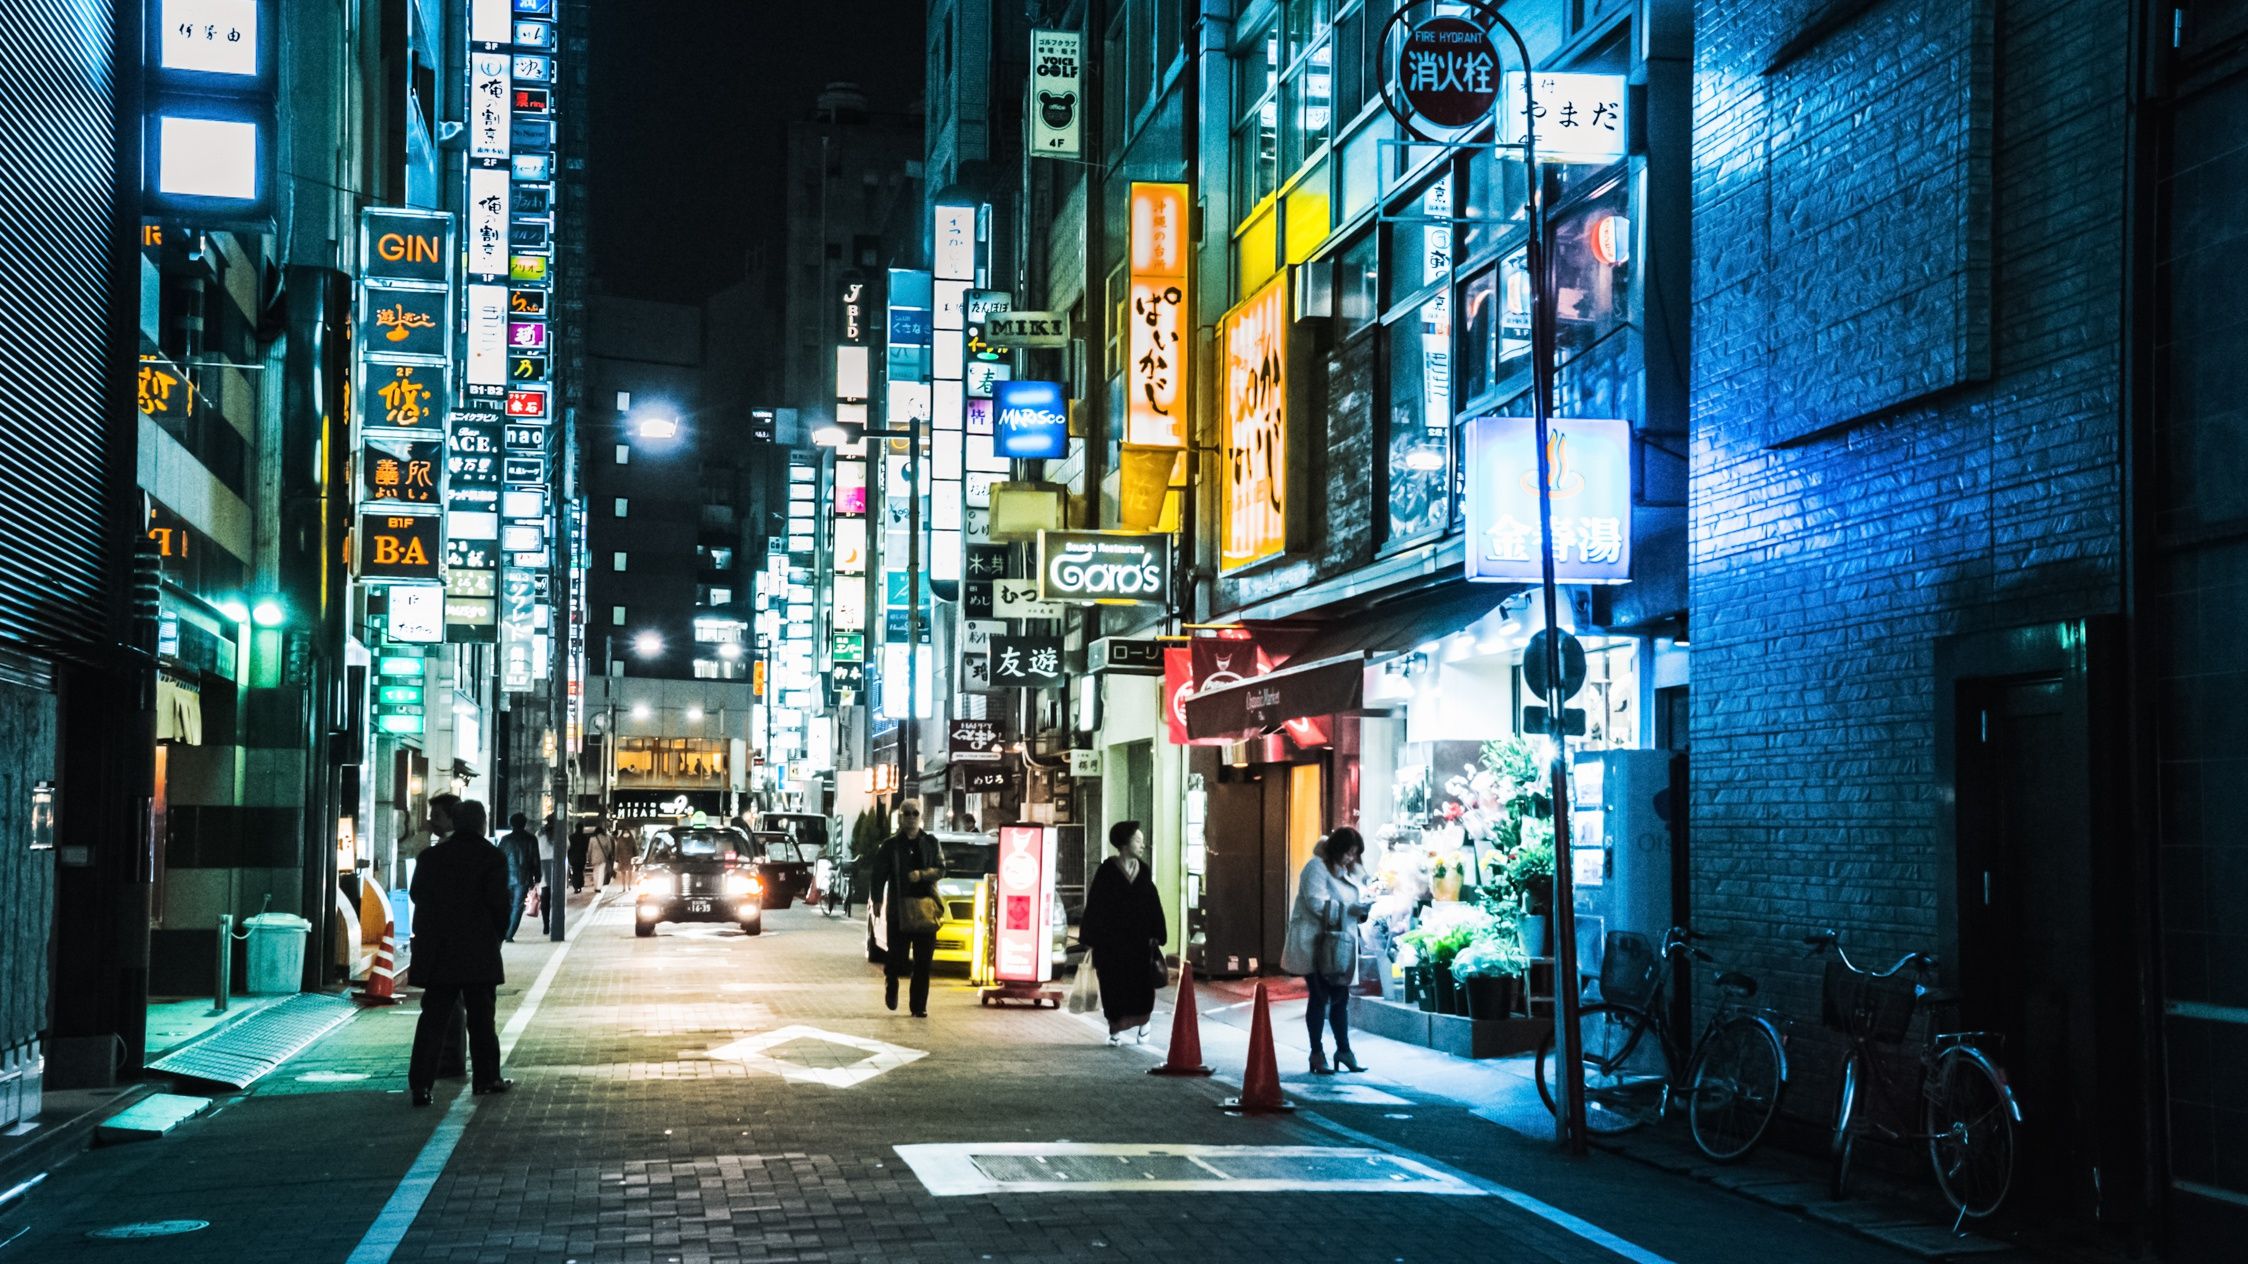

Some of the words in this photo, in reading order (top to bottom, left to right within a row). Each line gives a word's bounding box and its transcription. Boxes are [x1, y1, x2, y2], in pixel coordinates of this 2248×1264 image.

[1415, 31, 1436, 42] FIRE
[1439, 32, 1483, 43] HYDRANT
[1043, 57, 1074, 66] VOICE
[1037, 65, 1078, 79] GOLF
[1409, 50, 1494, 93] 消火栓
[1520, 101, 1619, 131] やまだ
[1049, 138, 1065, 147] 4F
[378, 233, 439, 264] GIN
[991, 320, 1063, 336] MIKI
[1136, 287, 1182, 416] ぱいかじ
[397, 367, 413, 376] 2F
[378, 379, 423, 425] 悠
[507, 430, 542, 443] nao
[388, 517, 414, 528] B1F
[1065, 542, 1096, 553] Sounds
[1098, 543, 1145, 554] Restaurant
[997, 646, 1058, 678] 友遊
